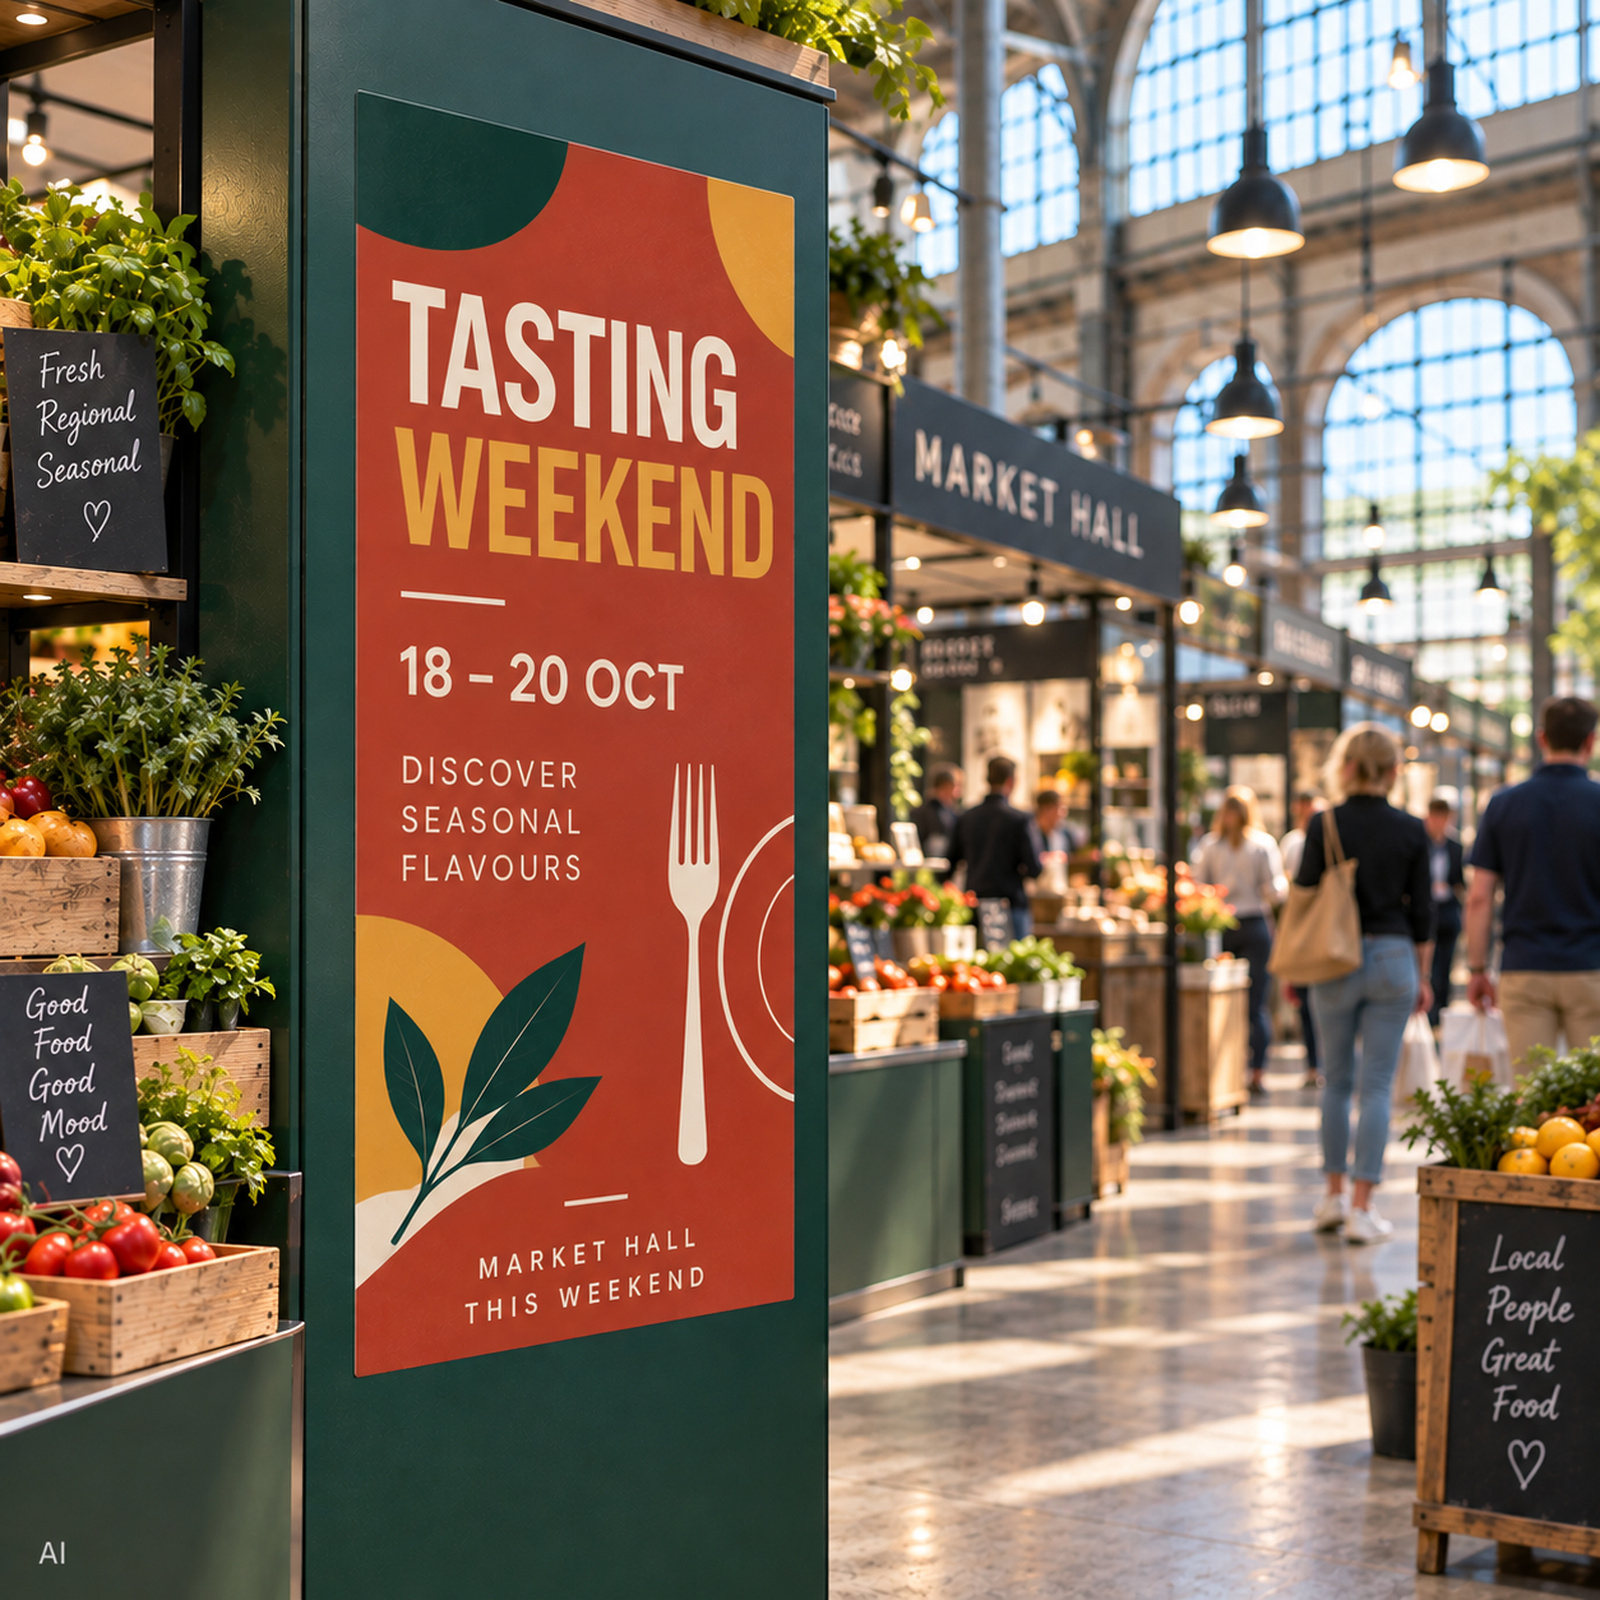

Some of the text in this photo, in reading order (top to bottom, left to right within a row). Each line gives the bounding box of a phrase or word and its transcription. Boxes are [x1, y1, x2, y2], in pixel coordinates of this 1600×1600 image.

[39, 349, 105, 389] Fresh
[392, 279, 738, 450] TASTING
[37, 390, 137, 439] Regional
[36, 438, 142, 490] Seasonal
[394, 426, 774, 580] WEEKEND
[914, 428, 1060, 528] MARKET
[1069, 489, 1145, 560] HALL
[400, 645, 453, 698] 18
[509, 652, 569, 705] 20
[585, 658, 684, 711] OCT
[402, 755, 577, 789] DISCOVER
[401, 805, 581, 835] SEASONAL
[402, 854, 581, 882] FLAVOURS
[25, 984, 89, 1022] Good
[33, 1023, 93, 1060] Food
[28, 1062, 96, 1104] Good
[39, 1100, 108, 1142] Mood
[479, 1227, 696, 1280] MARKET HALL
[1488, 1234, 1566, 1274] Local
[464, 1265, 706, 1325] THIS WEEKEND
[1486, 1284, 1575, 1335] People
[1481, 1336, 1562, 1377] Great
[1492, 1383, 1561, 1422] Food
